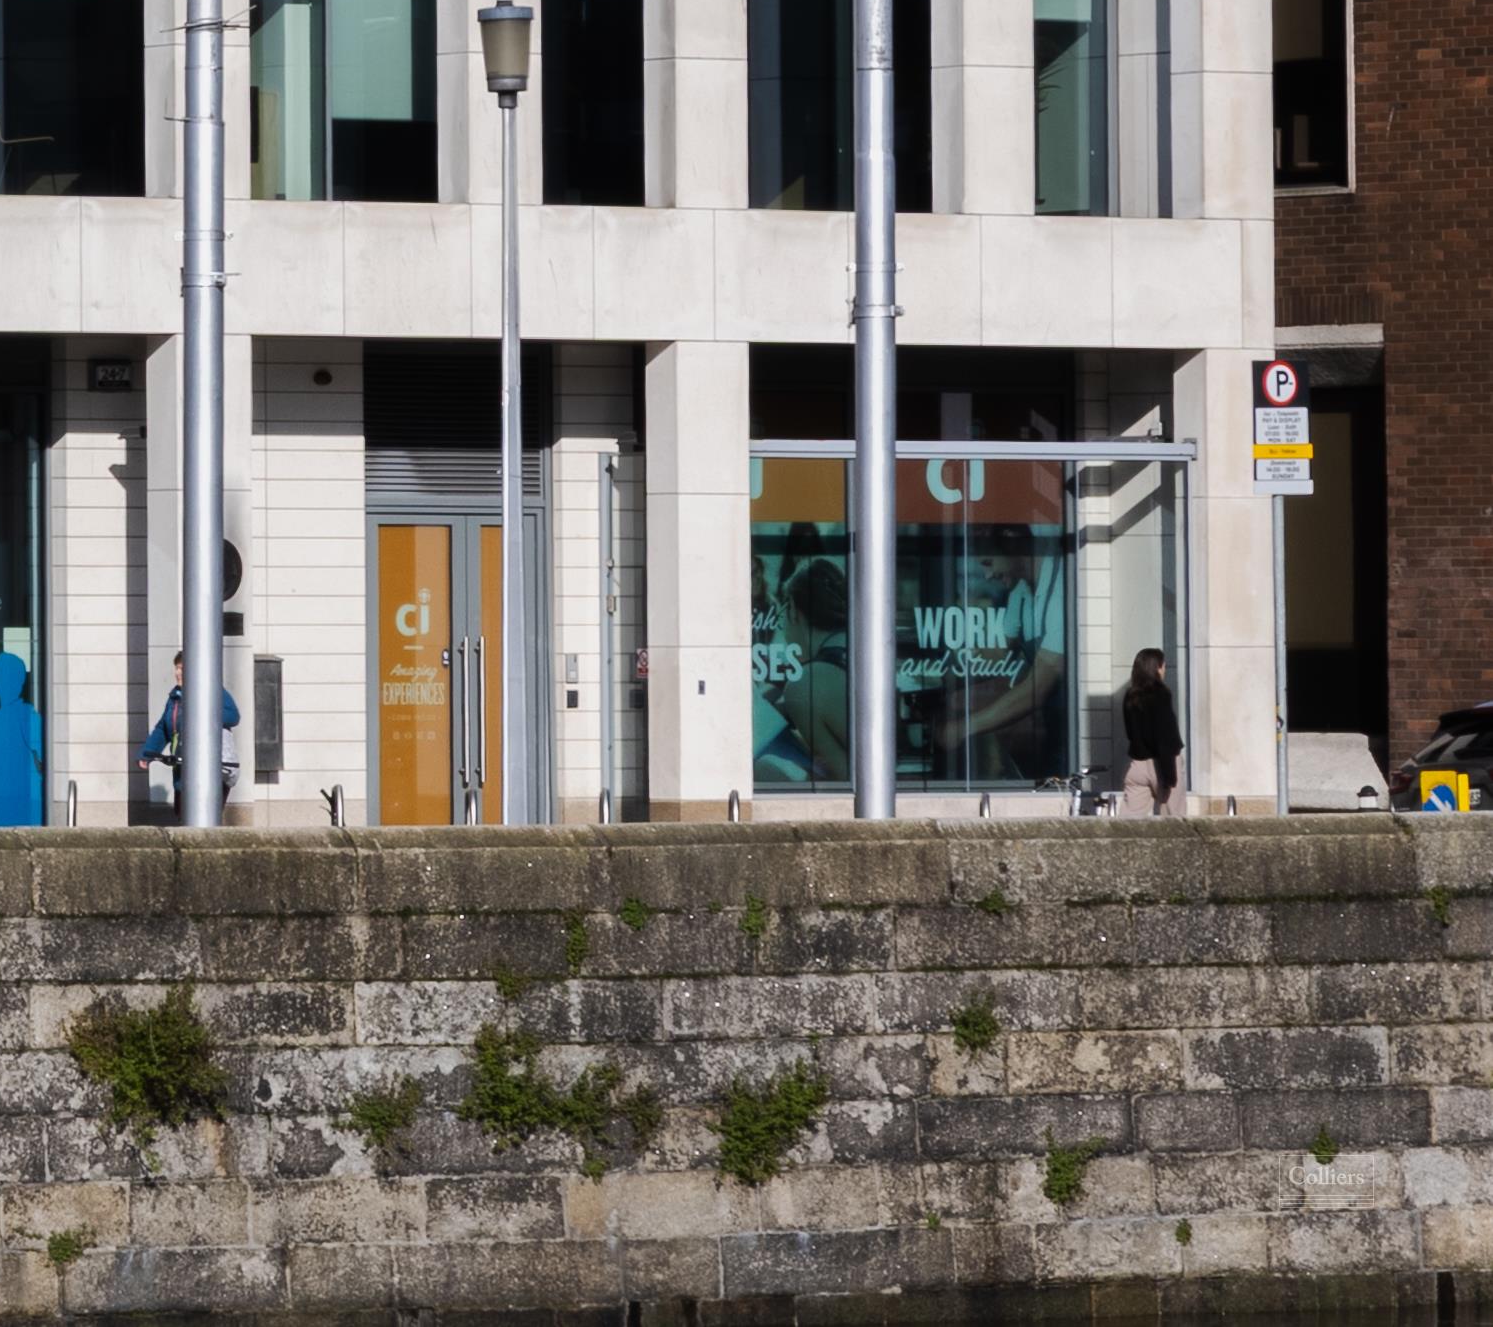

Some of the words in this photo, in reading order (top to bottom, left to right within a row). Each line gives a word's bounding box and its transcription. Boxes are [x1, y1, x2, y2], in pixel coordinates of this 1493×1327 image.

[914, 607, 1008, 649] WORK
[898, 650, 951, 677] and
[952, 649, 1025, 690] Study
[383, 682, 445, 706] EXPERIENCES
